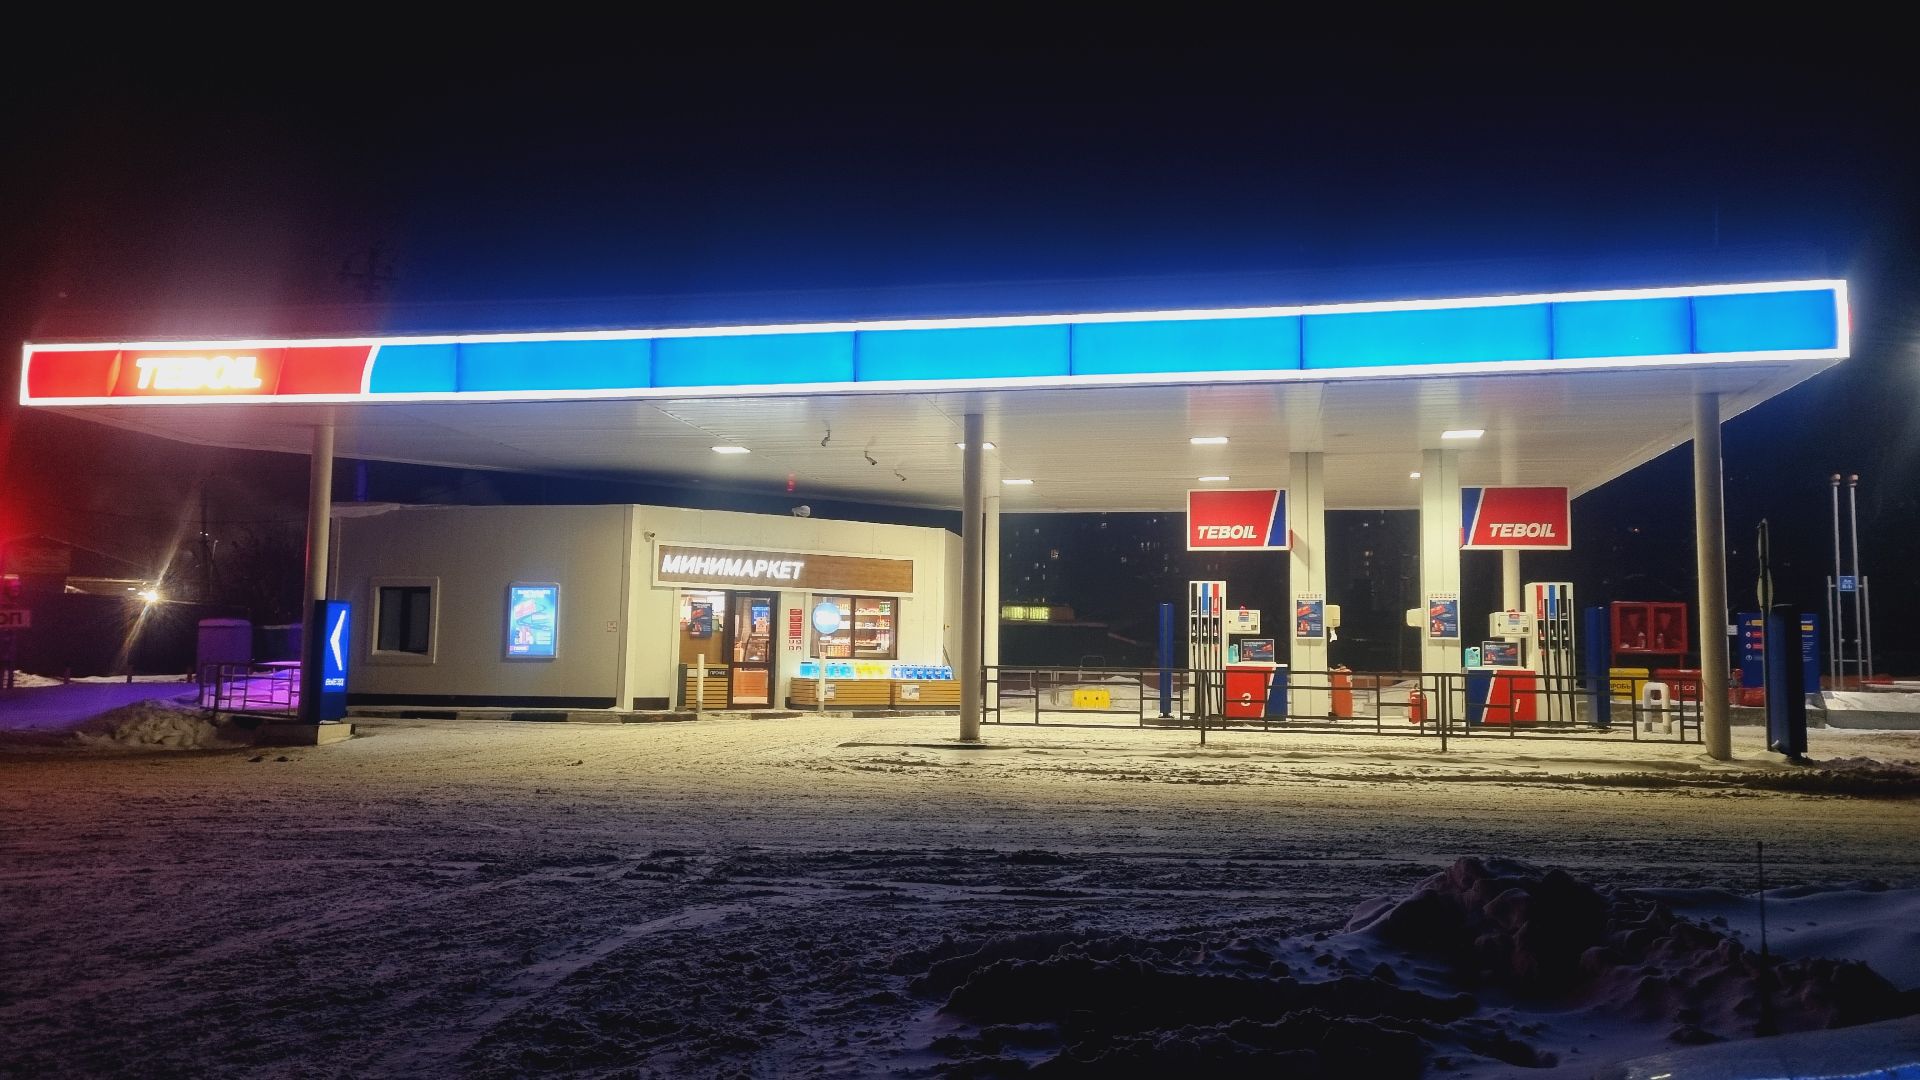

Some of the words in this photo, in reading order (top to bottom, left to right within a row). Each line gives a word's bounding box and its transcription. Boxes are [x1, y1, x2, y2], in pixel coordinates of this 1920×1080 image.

[136, 356, 262, 389] TEBOIL
[1198, 525, 1257, 539] TEBOIL
[1490, 523, 1556, 537] TEBOIL
[661, 554, 804, 579] МИНИМАРКЕТ
[1240, 692, 1252, 707] 3
